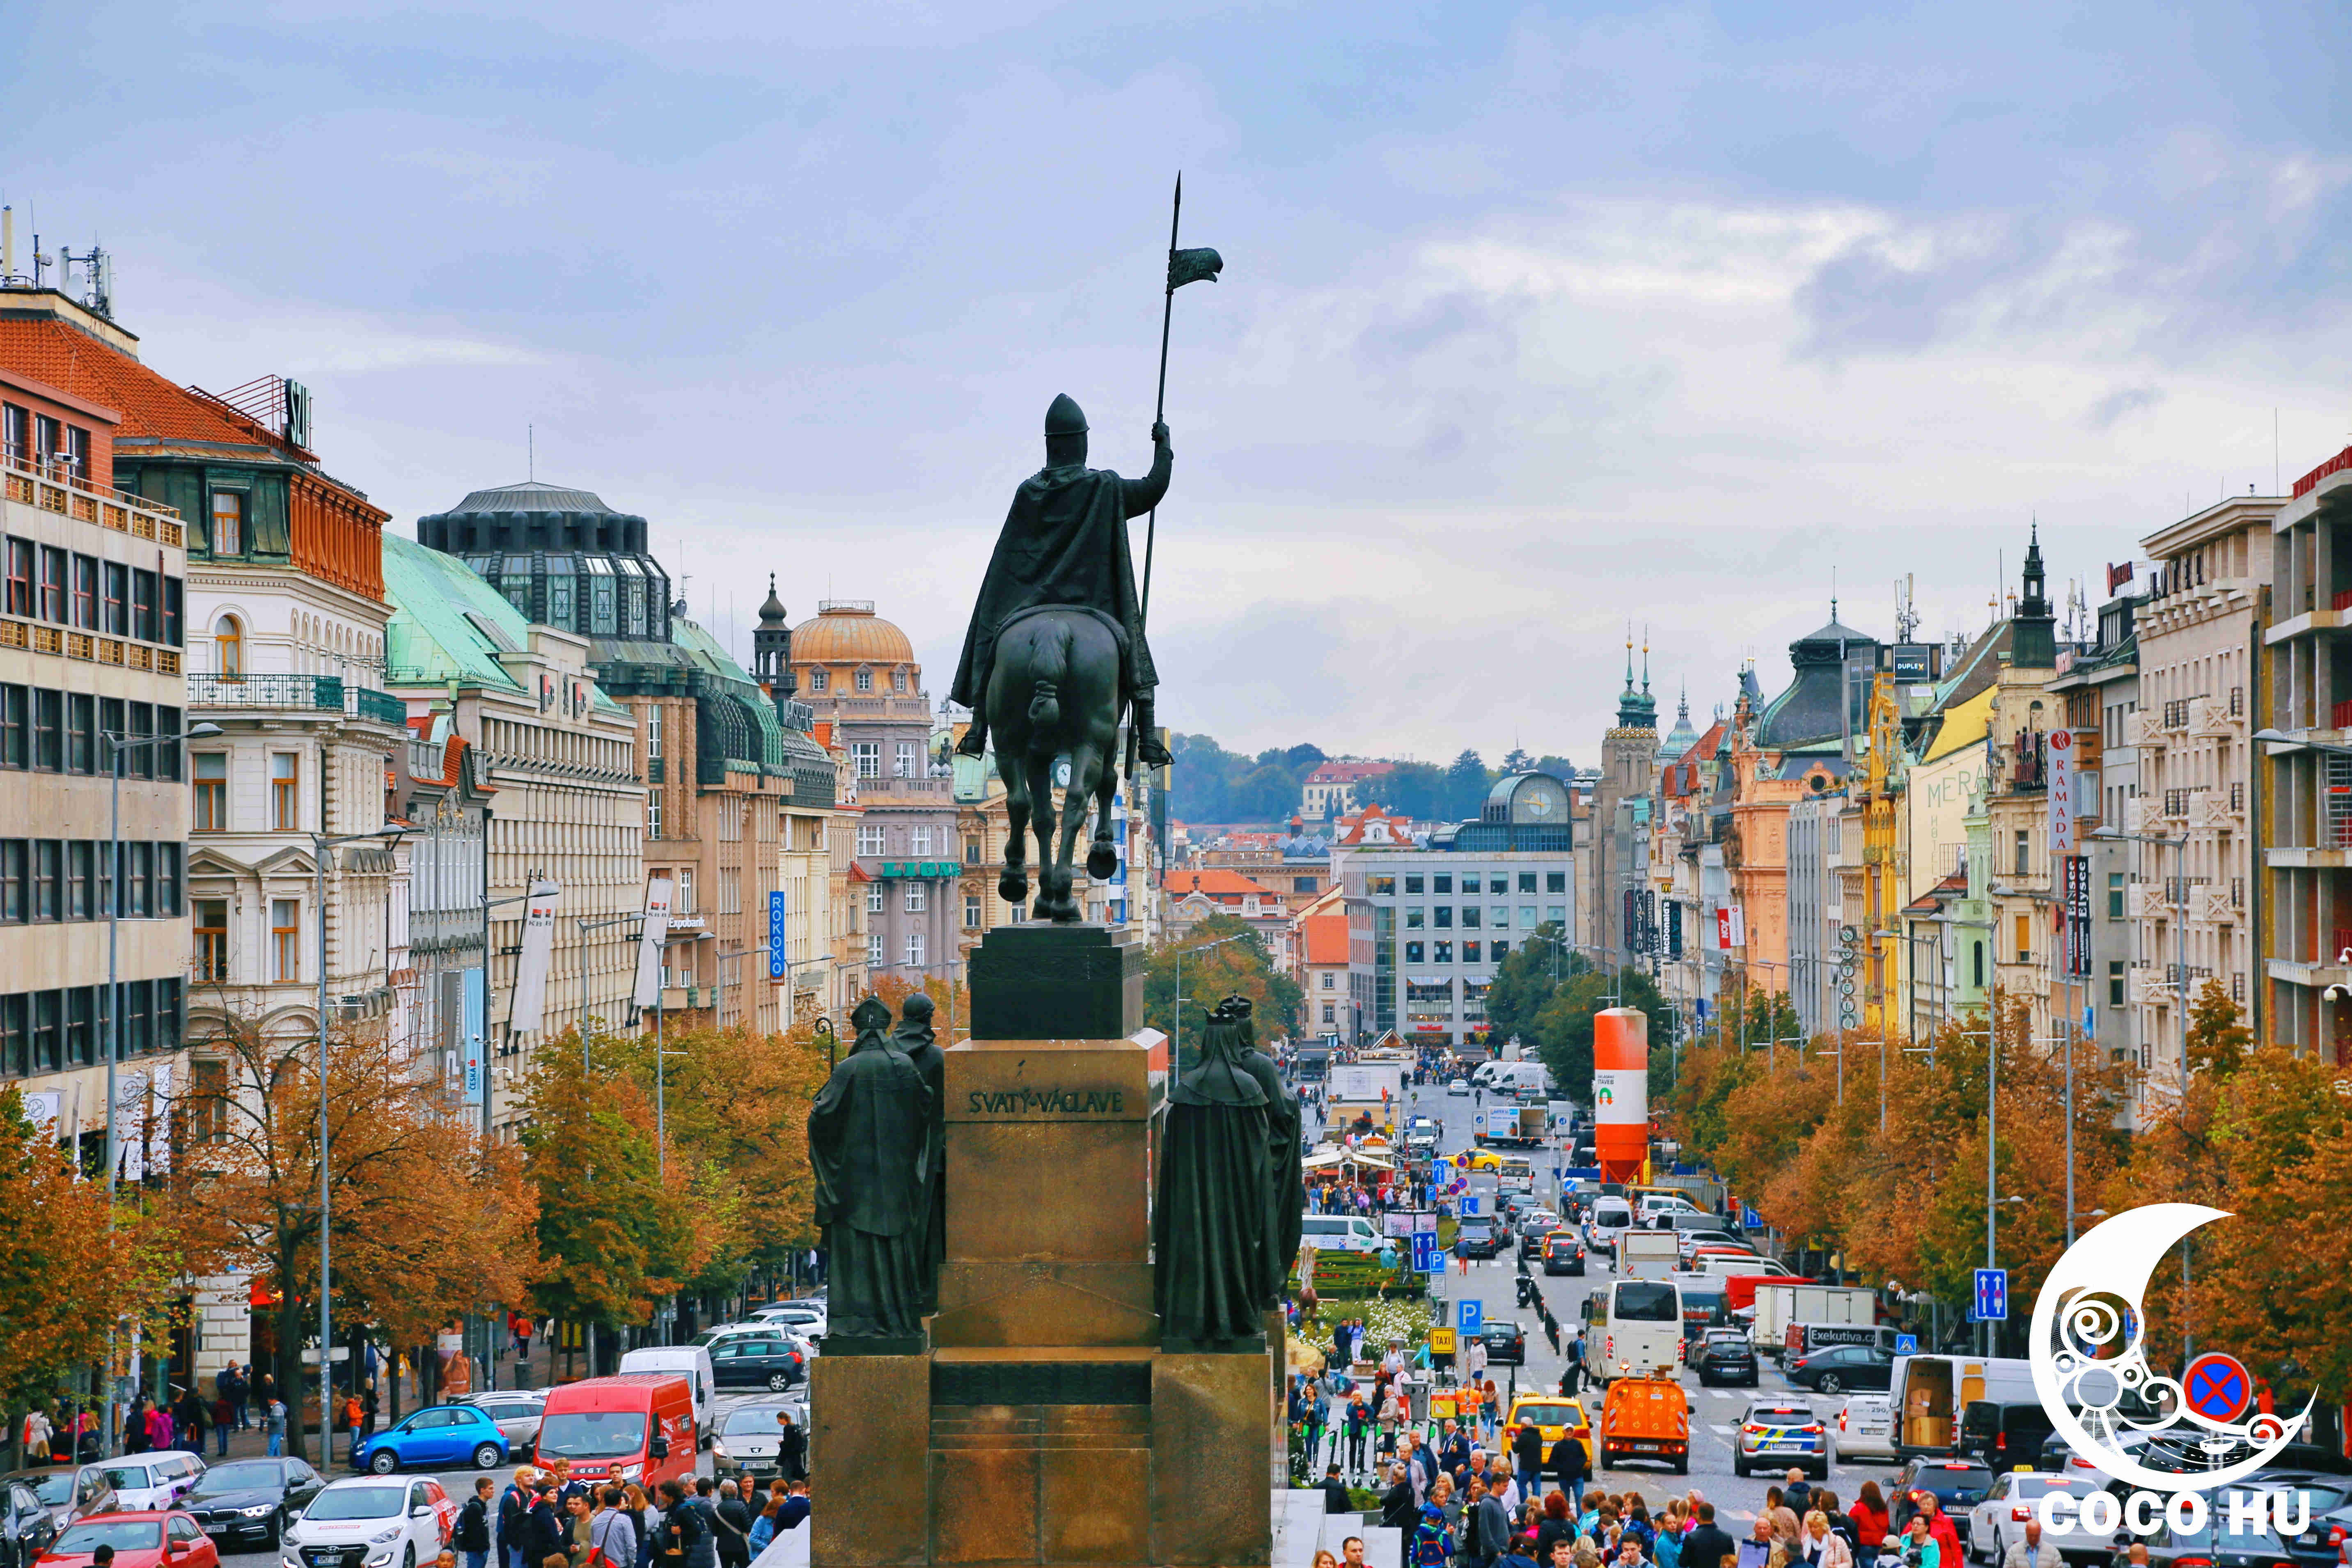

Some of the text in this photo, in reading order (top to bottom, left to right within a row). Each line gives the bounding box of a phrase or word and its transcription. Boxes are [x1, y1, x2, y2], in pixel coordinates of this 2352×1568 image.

[2055, 760, 2068, 849] RAMADA
[2079, 861, 2088, 918] Elysee
[669, 917, 705, 930] Expobank
[1671, 910, 1680, 951] GATE
[772, 897, 782, 974] ROKOKO
[1428, 1187, 1434, 1196] P
[1433, 1254, 1442, 1267] P
[1463, 1304, 1477, 1325] P
[1435, 1336, 1451, 1345] TAXI
[1811, 1328, 1875, 1343] Exekutiva.cz
